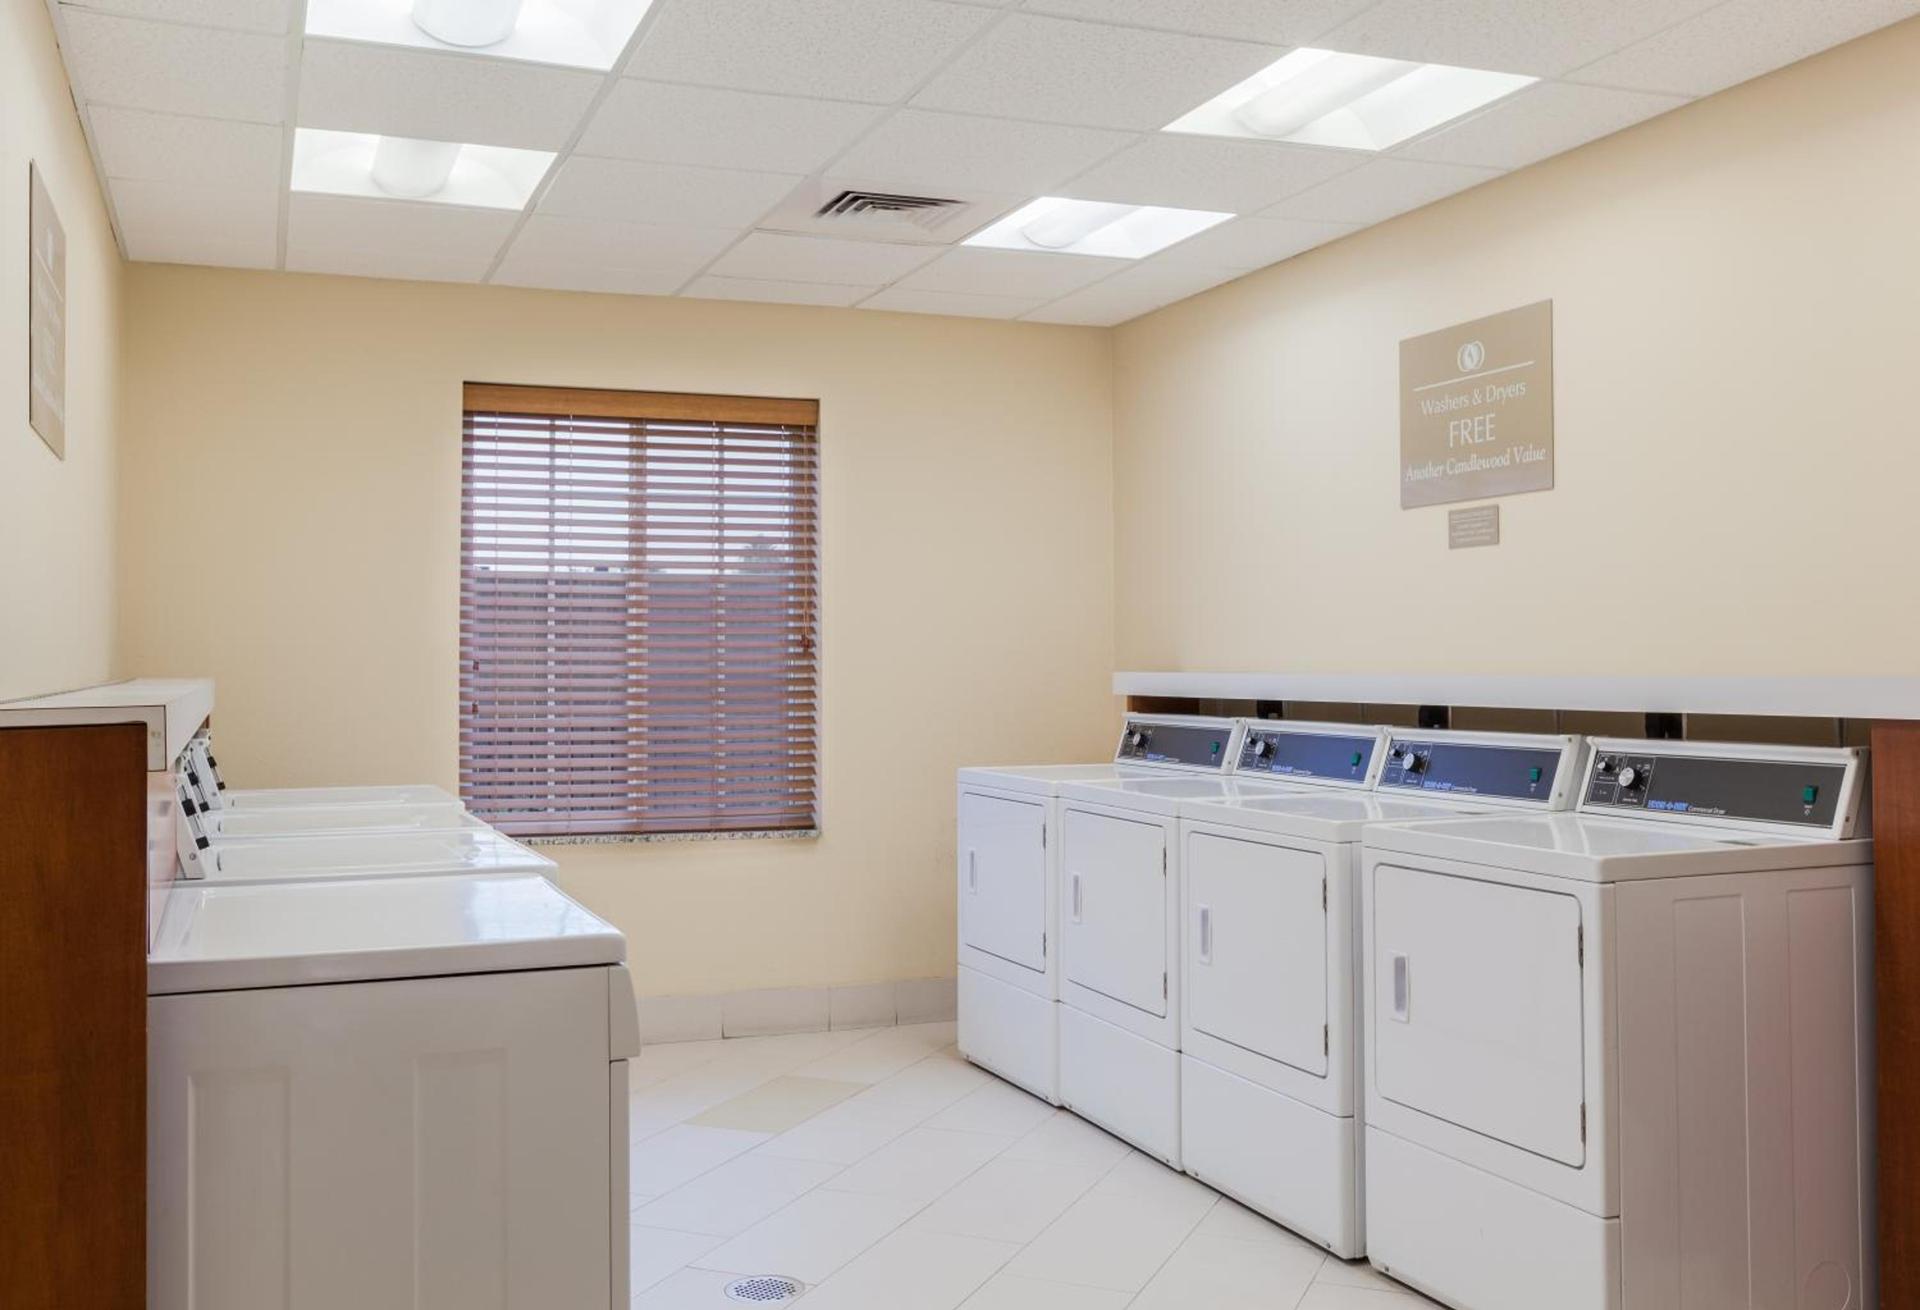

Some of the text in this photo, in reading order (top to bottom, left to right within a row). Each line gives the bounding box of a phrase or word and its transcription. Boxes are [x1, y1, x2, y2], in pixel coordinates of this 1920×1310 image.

[1421, 381, 1527, 415] Washers & Dryers
[1449, 413, 1496, 449] FREE
[1405, 443, 1546, 481] Another Candlewood Value
